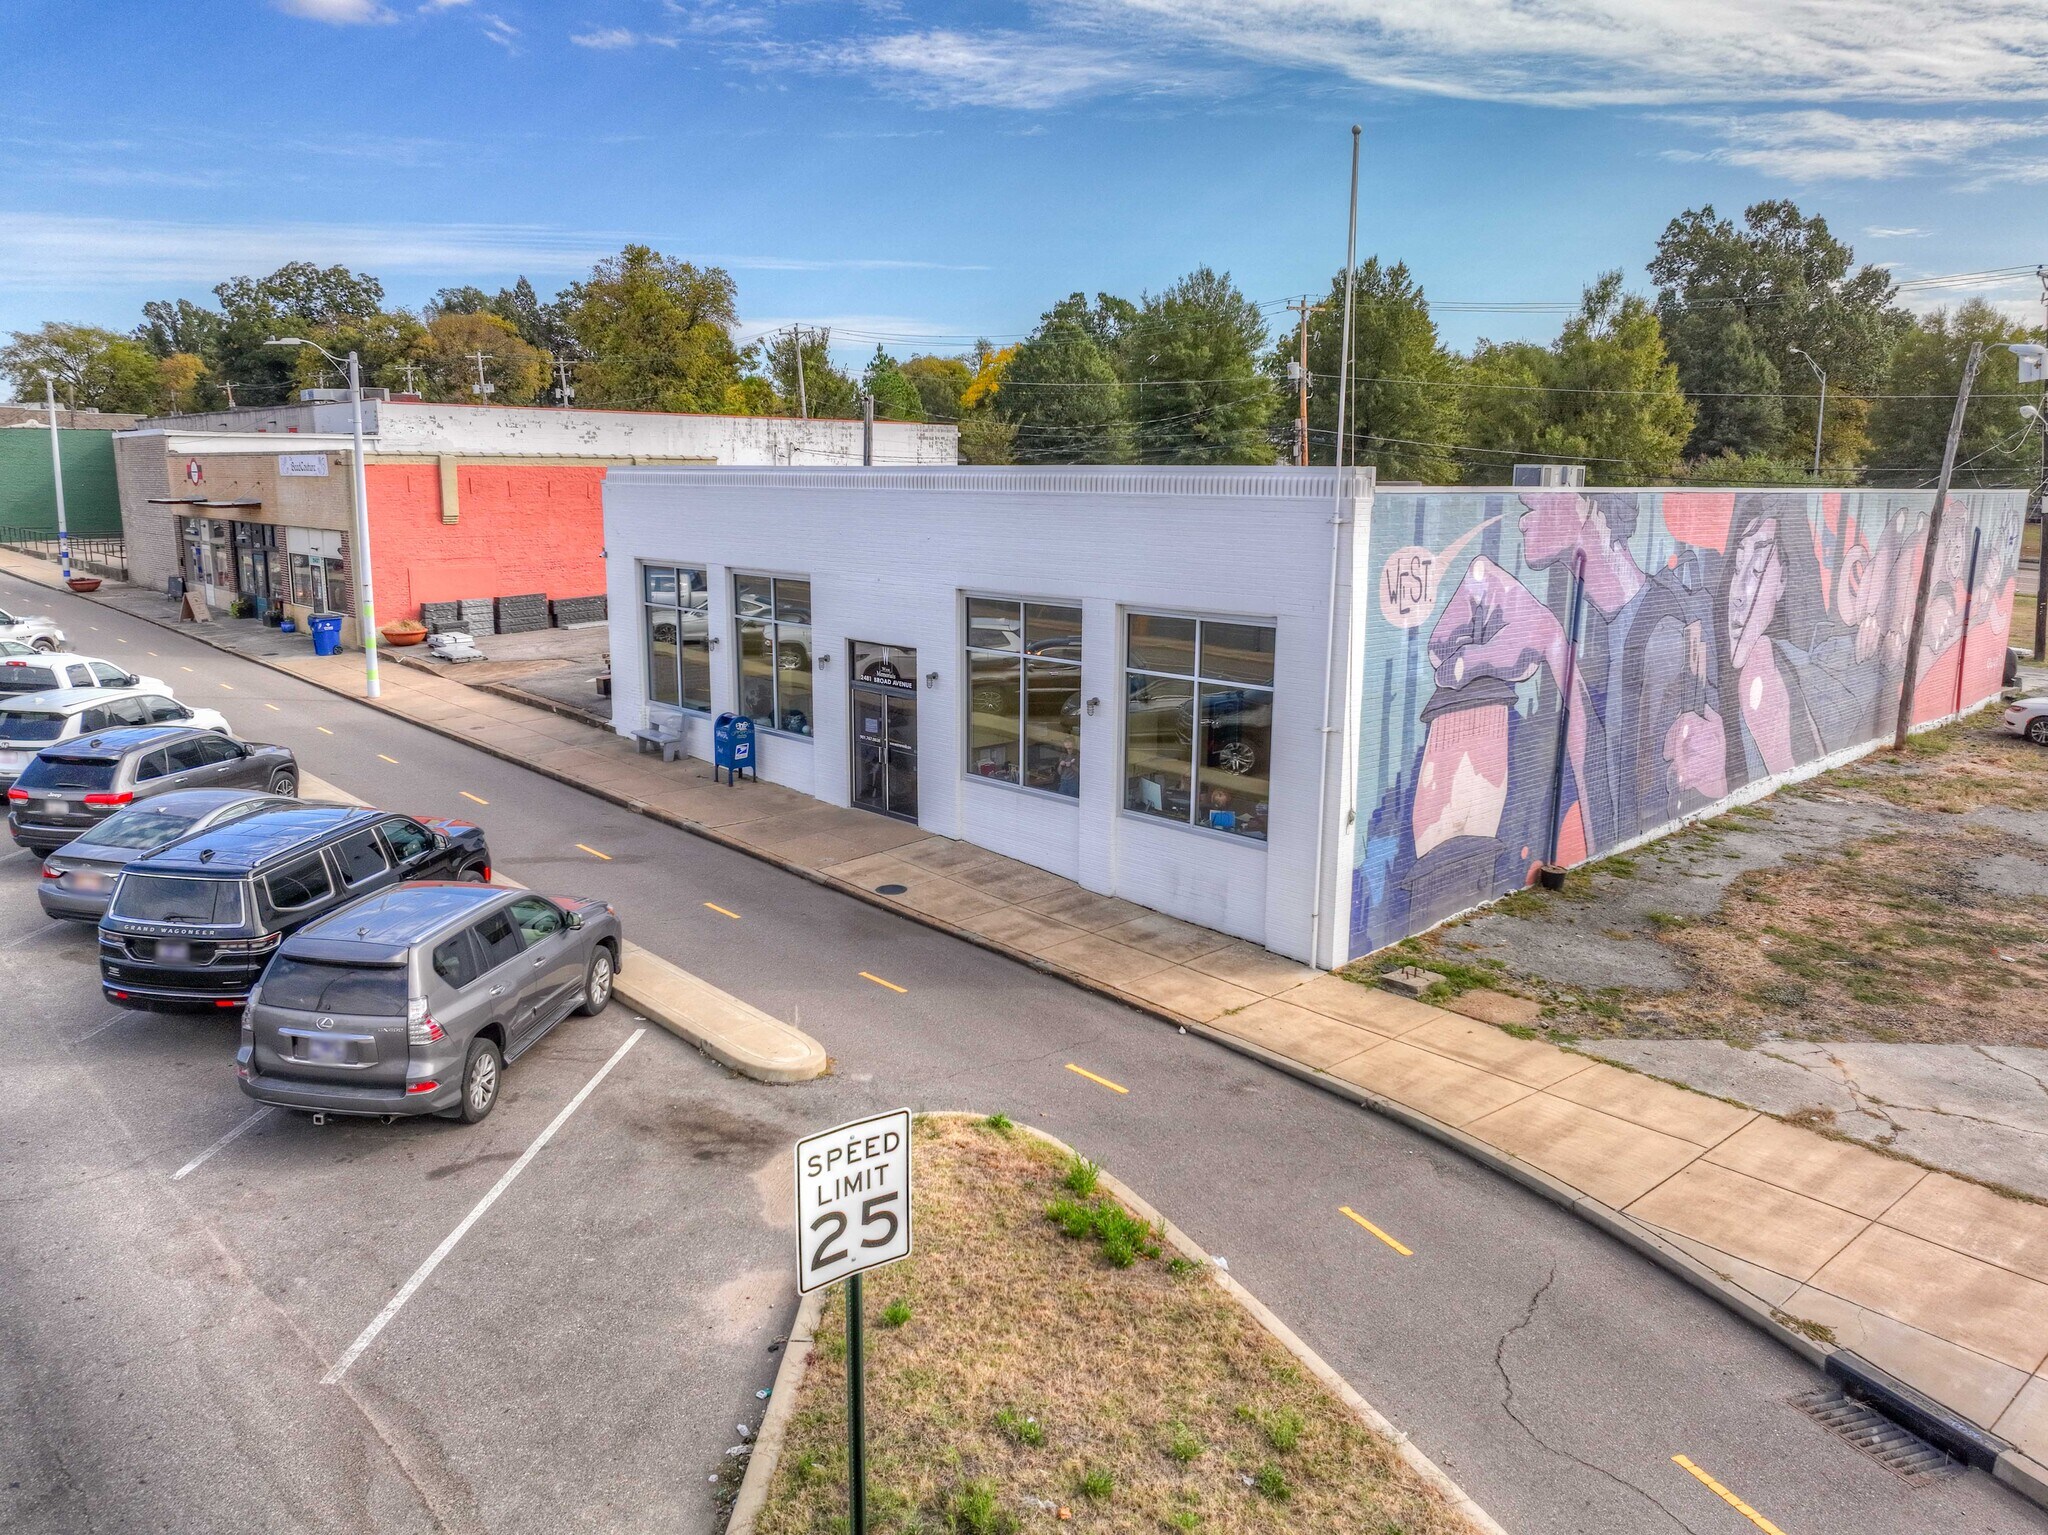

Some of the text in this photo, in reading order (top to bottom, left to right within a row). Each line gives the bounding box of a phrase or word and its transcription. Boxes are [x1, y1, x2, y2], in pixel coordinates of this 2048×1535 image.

[860, 674, 913, 689] 2481 BROAD AVENUE
[123, 924, 216, 936] GRAND WAGONEER
[807, 1131, 900, 1178] SPEED
[818, 1163, 889, 1207] LIMIT
[809, 1191, 899, 1272] 25
